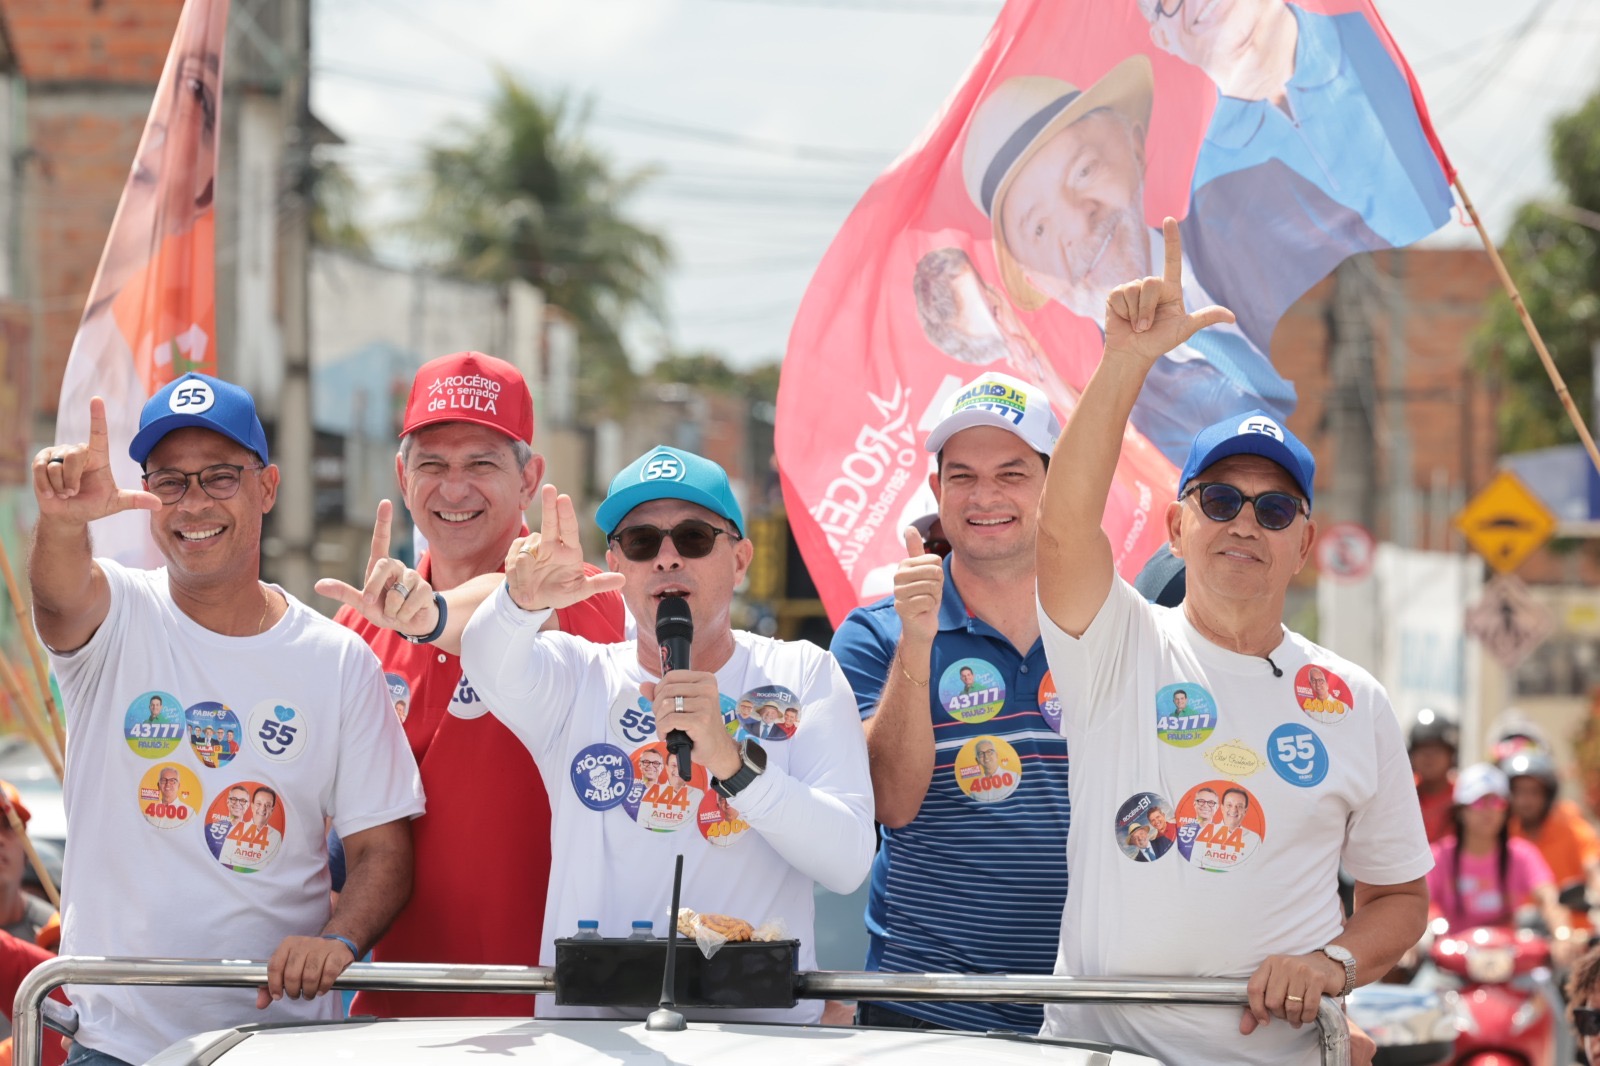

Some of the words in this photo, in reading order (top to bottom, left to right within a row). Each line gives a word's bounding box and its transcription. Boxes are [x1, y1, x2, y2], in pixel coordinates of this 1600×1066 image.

[444, 374, 501, 393] ROGÉRIO
[177, 388, 206, 407] 55
[447, 387, 454, 395] o
[457, 387, 499, 400] senador
[427, 398, 447, 412] de
[450, 395, 497, 415] LULA
[647, 460, 678, 480] 55
[779, 692, 792, 703] 131
[949, 687, 999, 710] 43777
[1045, 701, 1061, 711] 55
[1302, 697, 1345, 714] 4000
[130, 723, 180, 738] 43777
[619, 708, 657, 735] 55
[1157, 713, 1210, 730] 43777
[259, 719, 298, 746] 55
[1276, 733, 1316, 763] 55
[576, 754, 597, 775] #TÔ
[597, 754, 623, 767] COM
[584, 781, 626, 802] FABIO
[970, 772, 1013, 793] 4000
[641, 783, 690, 812] 444
[1138, 795, 1152, 811] 131
[145, 802, 188, 820] 4000
[651, 810, 684, 820] André
[210, 822, 229, 835] 55
[226, 821, 269, 850] 444
[1179, 826, 1197, 838] 55
[1195, 823, 1245, 853] 444
[234, 847, 262, 859] André
[1204, 849, 1238, 862] André
